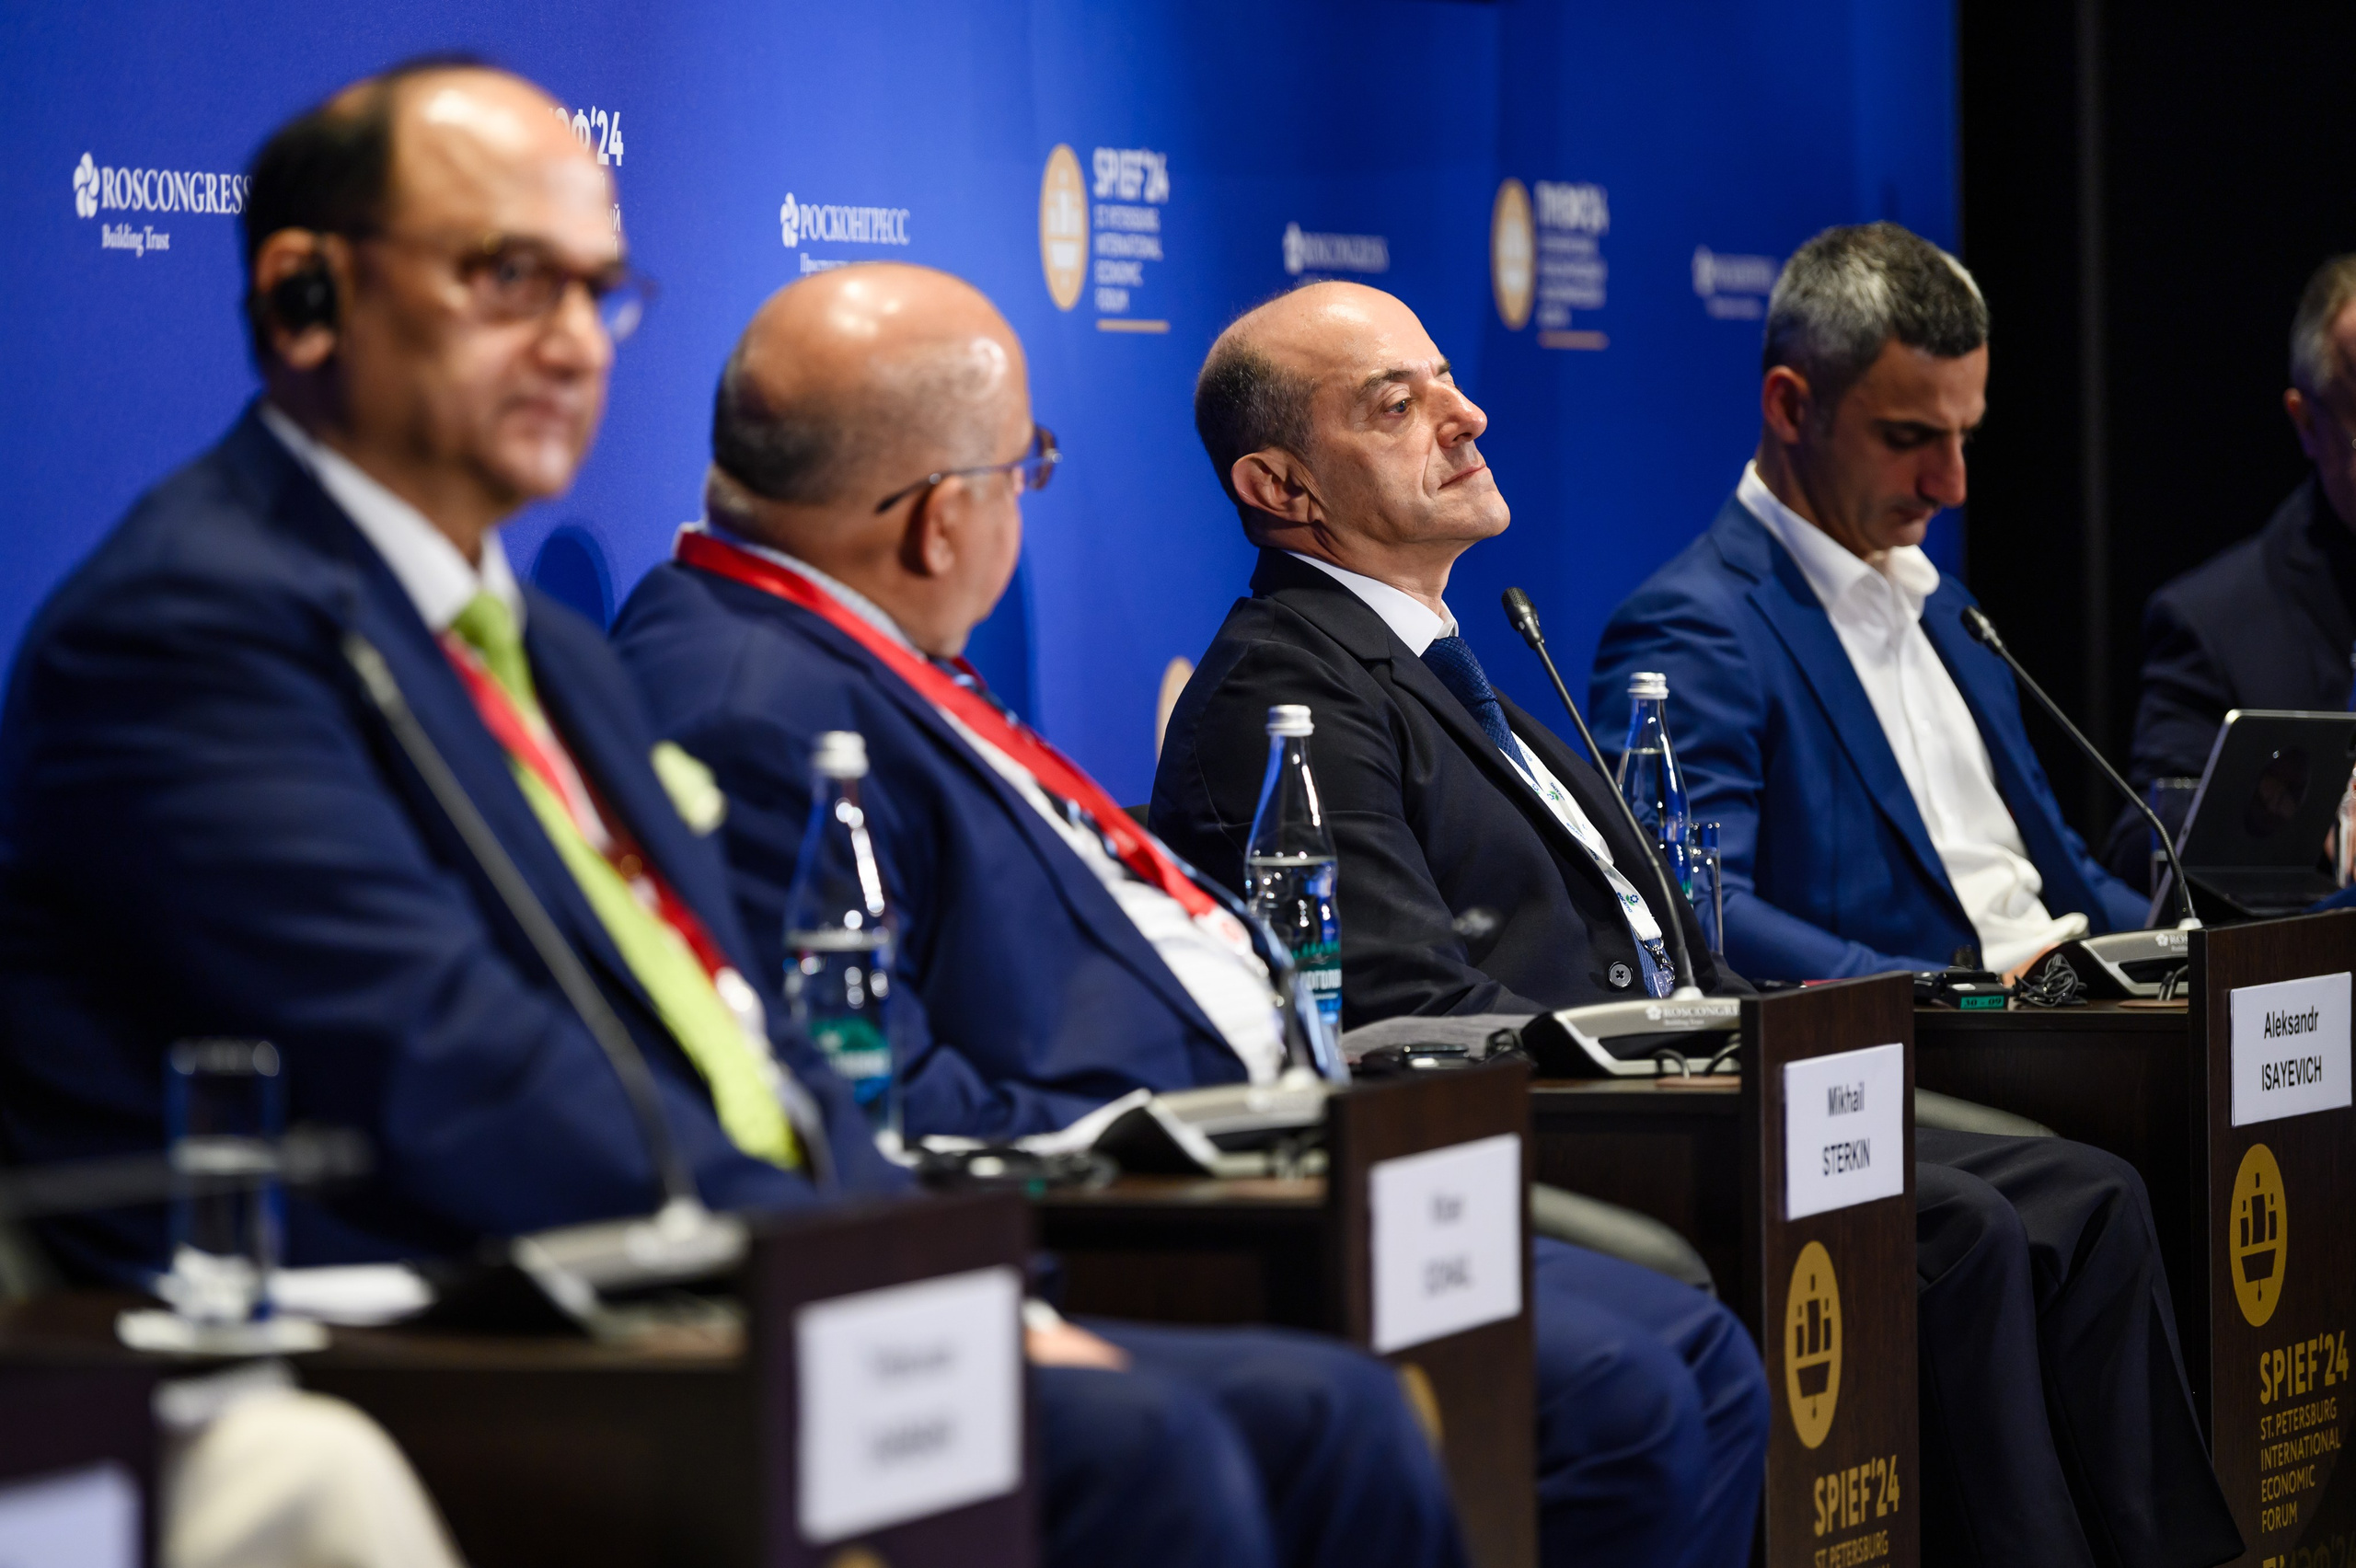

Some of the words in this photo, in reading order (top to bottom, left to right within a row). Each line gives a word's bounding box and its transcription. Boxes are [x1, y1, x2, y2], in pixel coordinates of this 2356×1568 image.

[101, 224, 144, 259] Building
[144, 225, 170, 250] Trust
[1662, 1005, 1738, 1018] ROSCONGR
[2263, 1005, 2319, 1040] Aleksandr
[2261, 1055, 2322, 1091] ISAYEVICH
[1827, 1081, 1865, 1117] Mikhail
[1822, 1138, 1871, 1177] STERKIN
[2259, 1330, 2350, 1405] SPIEF'24
[2260, 1414, 2274, 1441] ST.
[2276, 1396, 2338, 1432] PETERSBURG
[2260, 1426, 2342, 1472] INTERNATIONAL
[1813, 1454, 1900, 1538] SPIEF'24
[2261, 1464, 2316, 1503] ECONOMIC
[2261, 1500, 2298, 1534] FORUM
